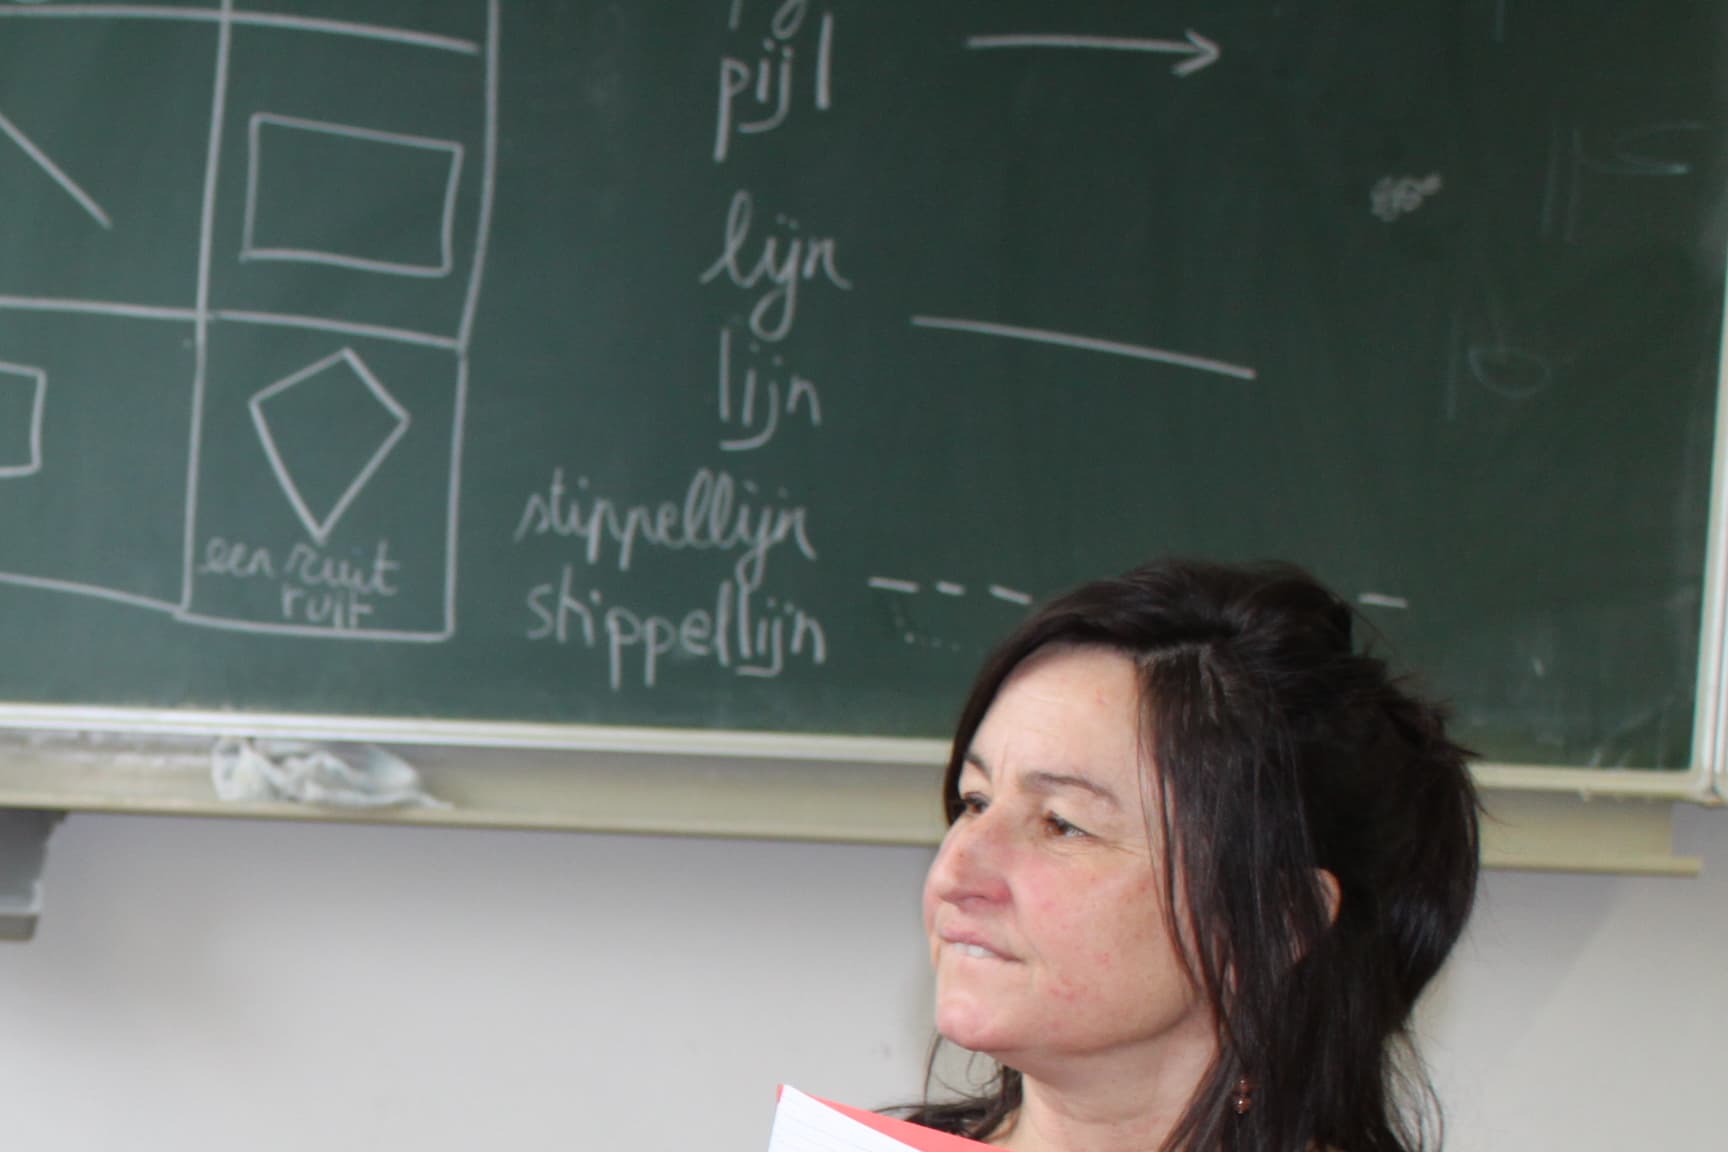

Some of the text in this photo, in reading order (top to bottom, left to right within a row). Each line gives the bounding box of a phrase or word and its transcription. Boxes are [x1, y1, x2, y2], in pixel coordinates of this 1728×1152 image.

[713, 12, 832, 163] pijl
[699, 190, 851, 341] lijn
[718, 326, 822, 452] lijn
[196, 535, 274, 578] een
[514, 466, 818, 592] stippellijn
[527, 563, 827, 692] stippellijn
